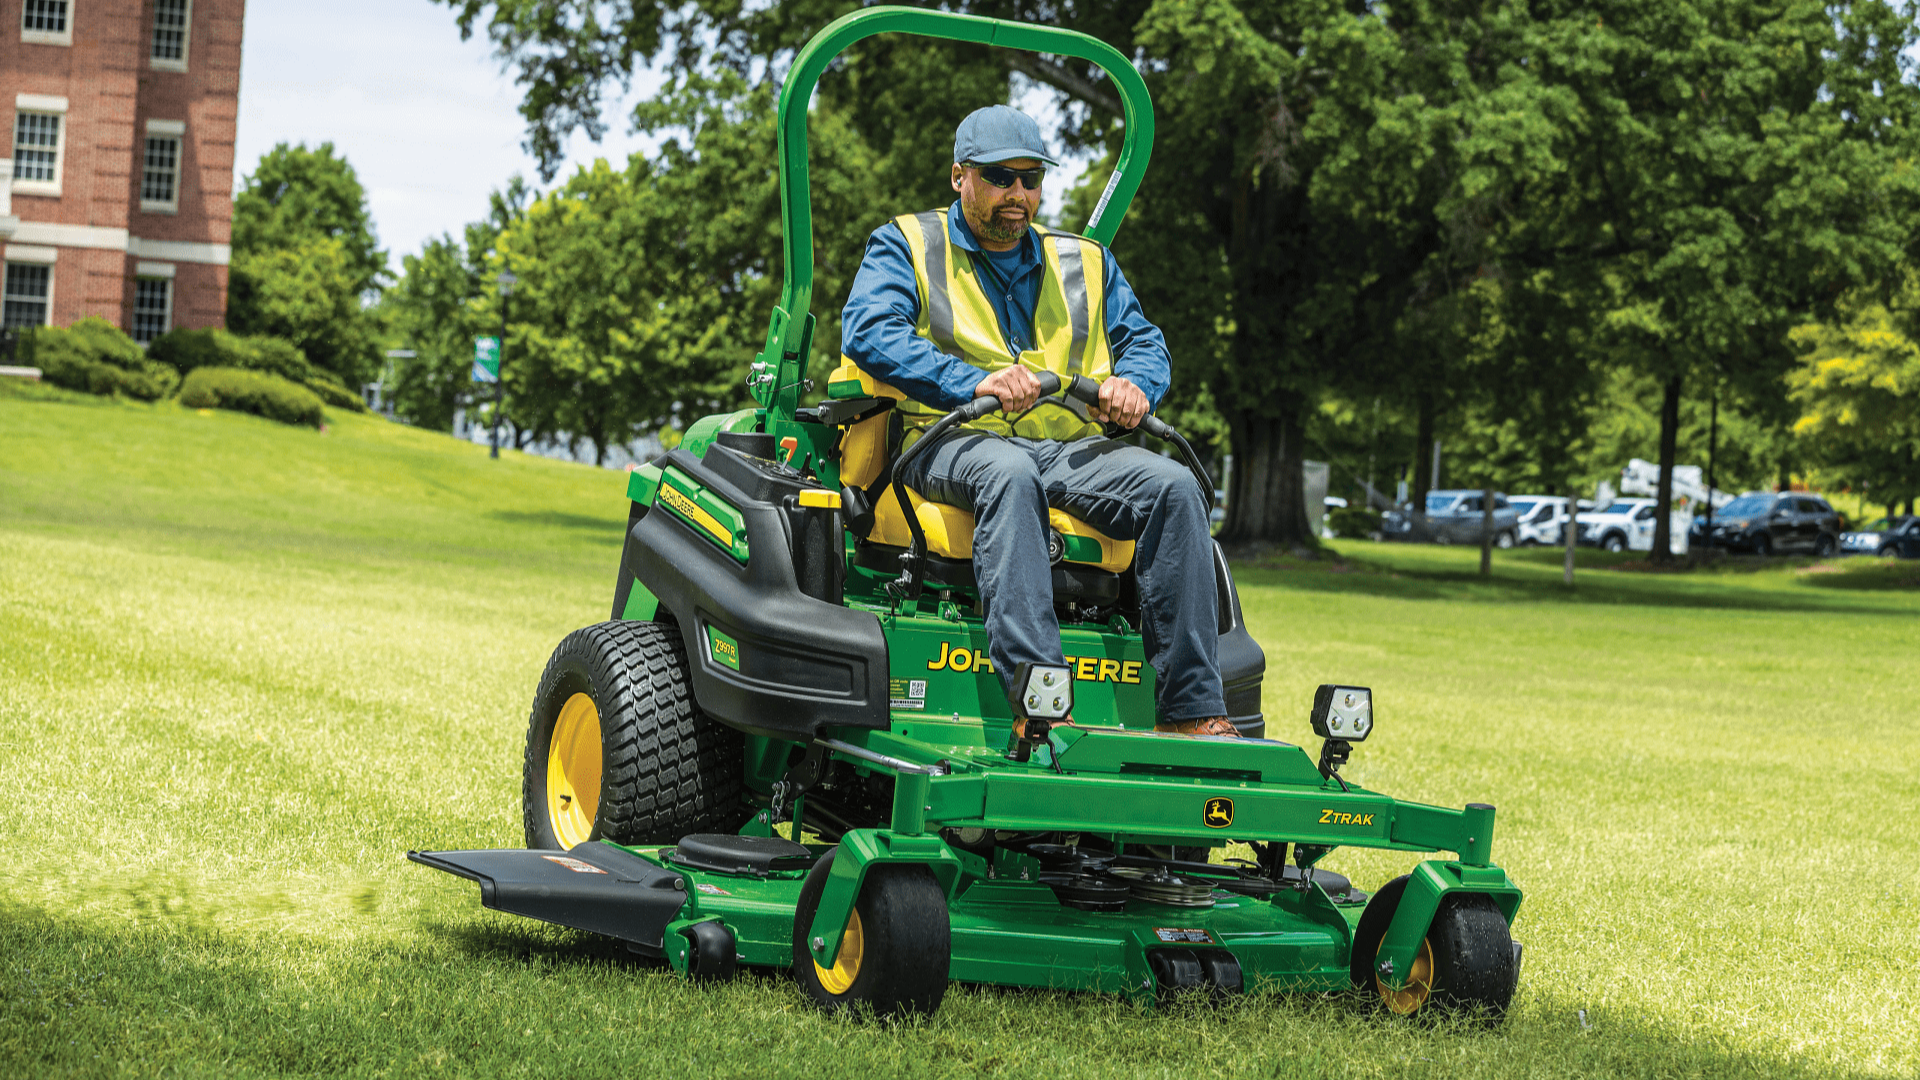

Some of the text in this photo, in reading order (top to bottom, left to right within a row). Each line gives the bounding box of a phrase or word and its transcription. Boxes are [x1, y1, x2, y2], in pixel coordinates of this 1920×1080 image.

[663, 486, 695, 519] JOHN DEERE
[715, 637, 735, 657] Z997R
[928, 641, 1143, 684] JOH ERE
[1318, 809, 1375, 825] ZTRAK
